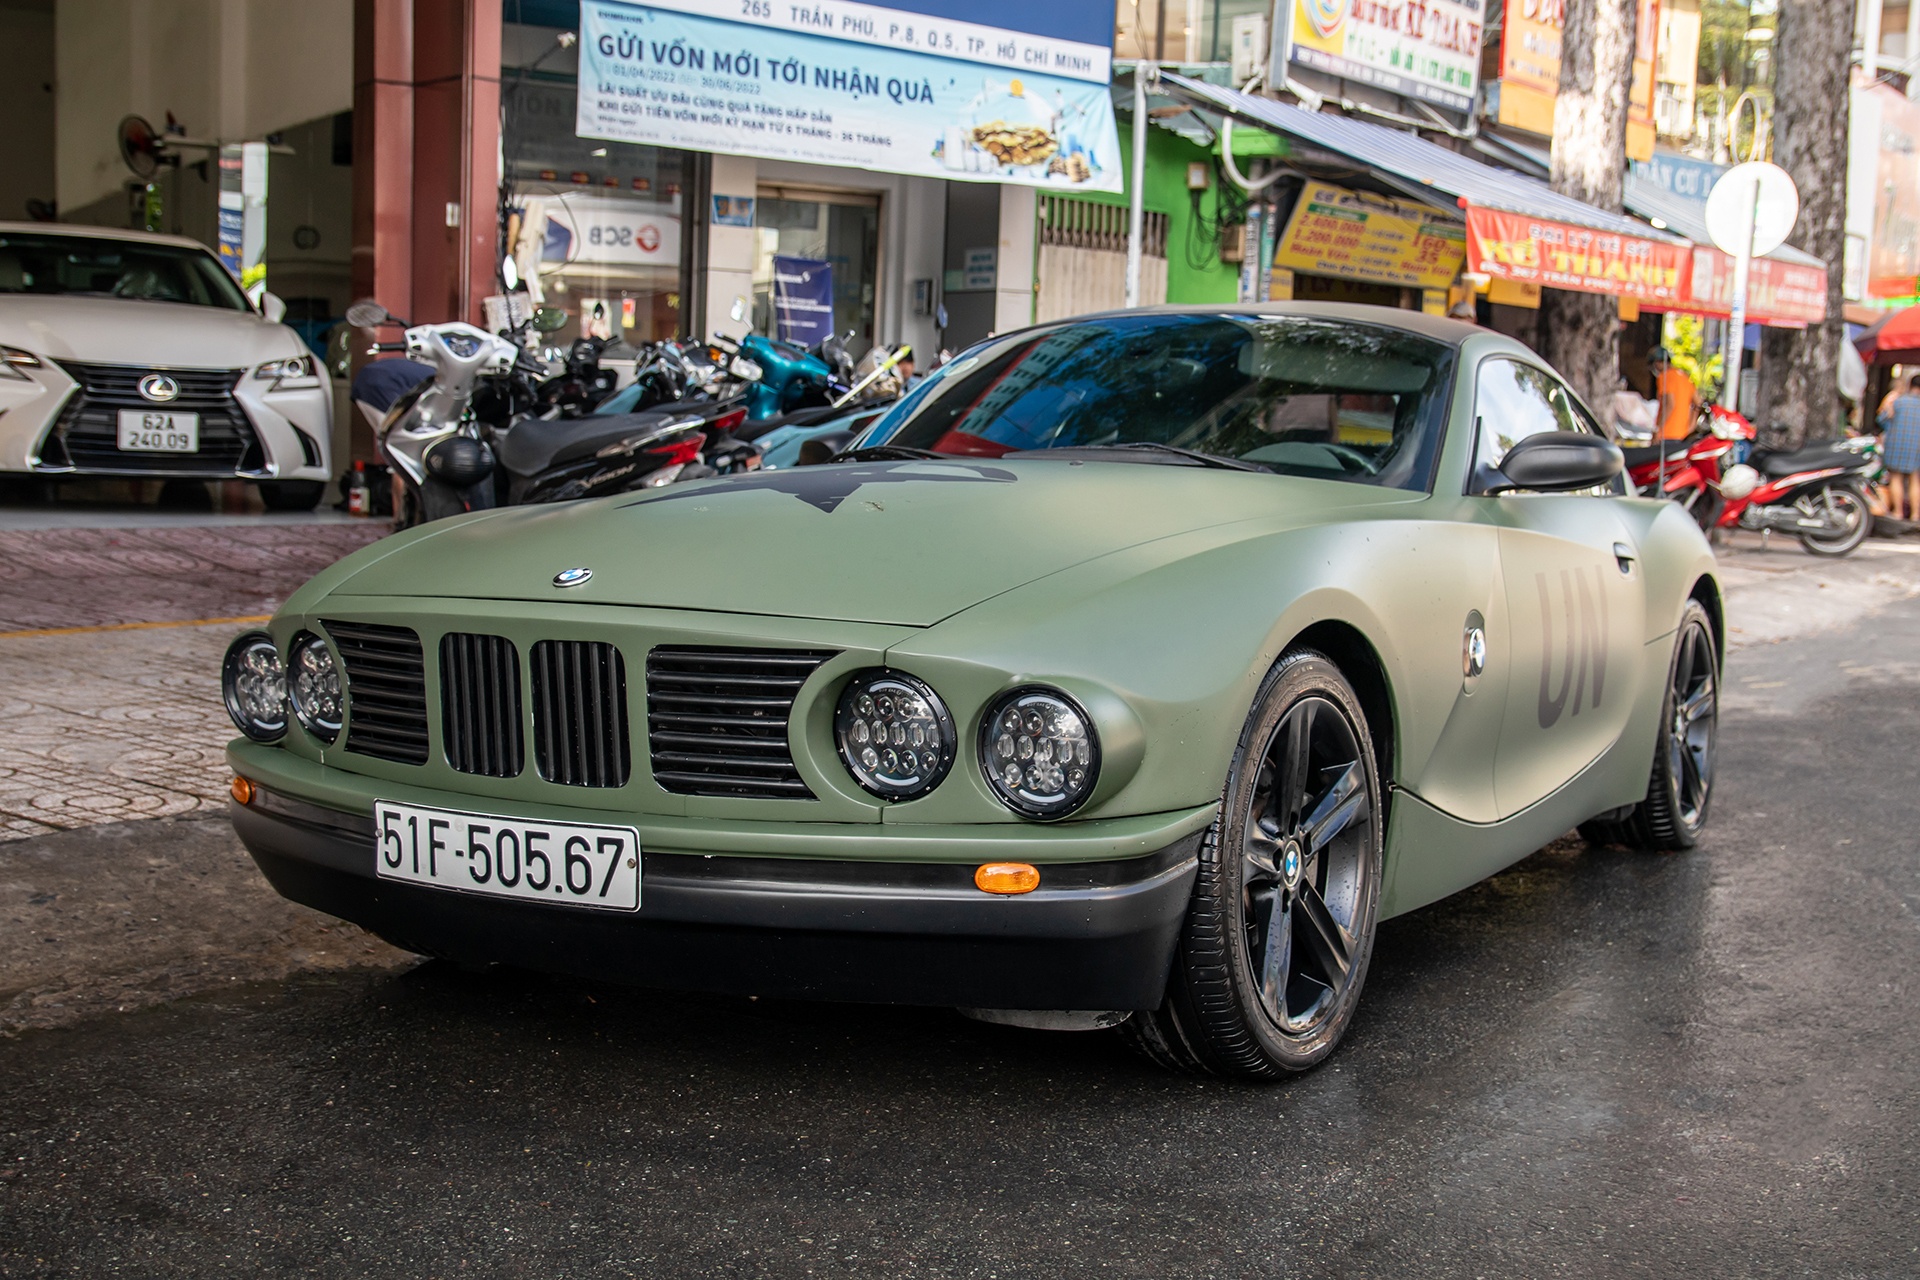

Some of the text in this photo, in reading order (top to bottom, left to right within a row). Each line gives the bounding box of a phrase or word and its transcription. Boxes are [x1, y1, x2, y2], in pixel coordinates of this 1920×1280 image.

[742, 0, 771, 18] 265
[790, 5, 833, 28] TRẦN
[842, 14, 878, 38] PHÚ,
[967, 37, 989, 56] TP.
[997, 40, 1016, 60] HỒ
[1024, 46, 1048, 65] CHÍ
[1055, 53, 1091, 72] MINH
[599, 29, 933, 104] GỬI VỐN MỚI TỚI NHẬN QUÀ
[674, 108, 697, 123] VỐN
[796, 123, 832, 140] THÁNG
[857, 132, 892, 147] THÁNG
[693, 94, 724, 110] CÙNG
[128, 431, 189, 450] 240.09
[143, 414, 175, 430] 62A
[1535, 564, 1609, 729] UN
[383, 810, 625, 898] 51F-505.67
